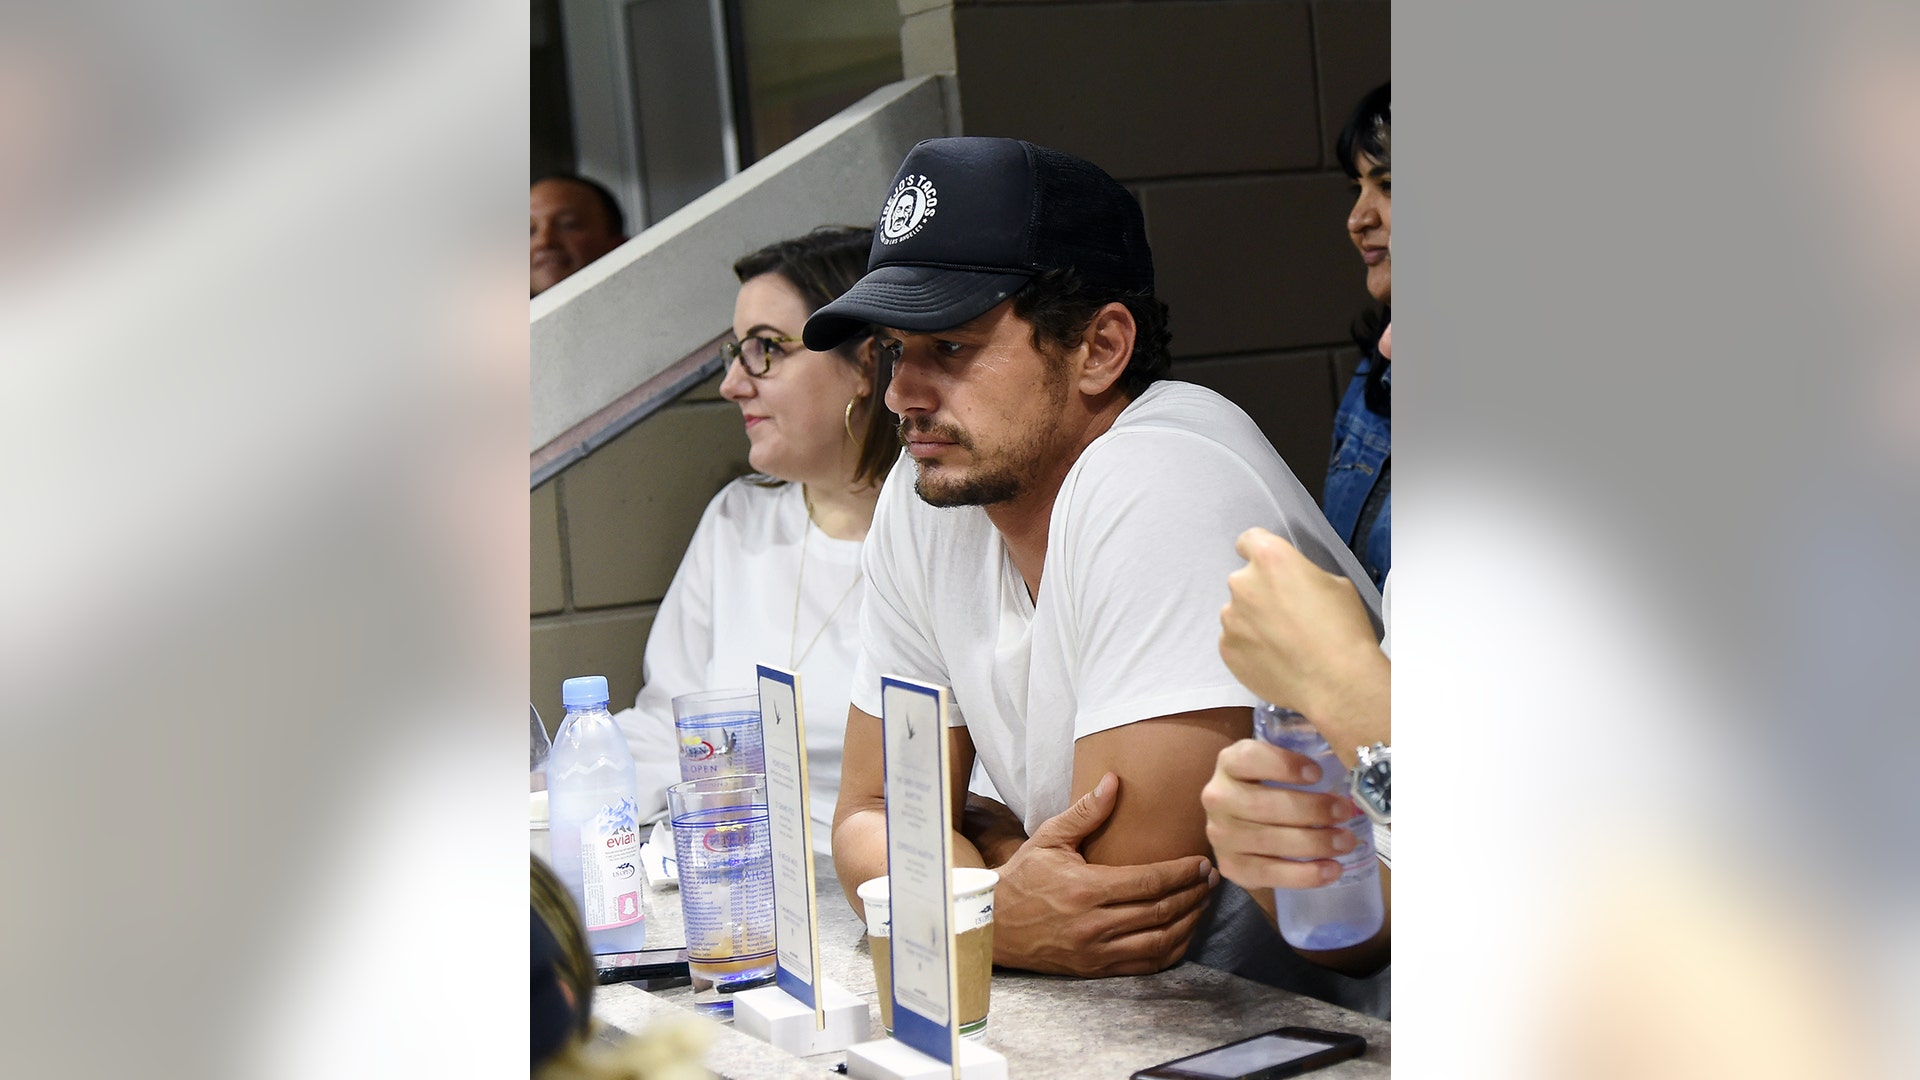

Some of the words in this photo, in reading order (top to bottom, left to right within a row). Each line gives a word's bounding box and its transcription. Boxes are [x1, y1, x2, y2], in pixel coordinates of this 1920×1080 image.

[916, 174, 938, 217] TACOS
[690, 764, 718, 773] OPEN
[606, 832, 636, 848] evian
